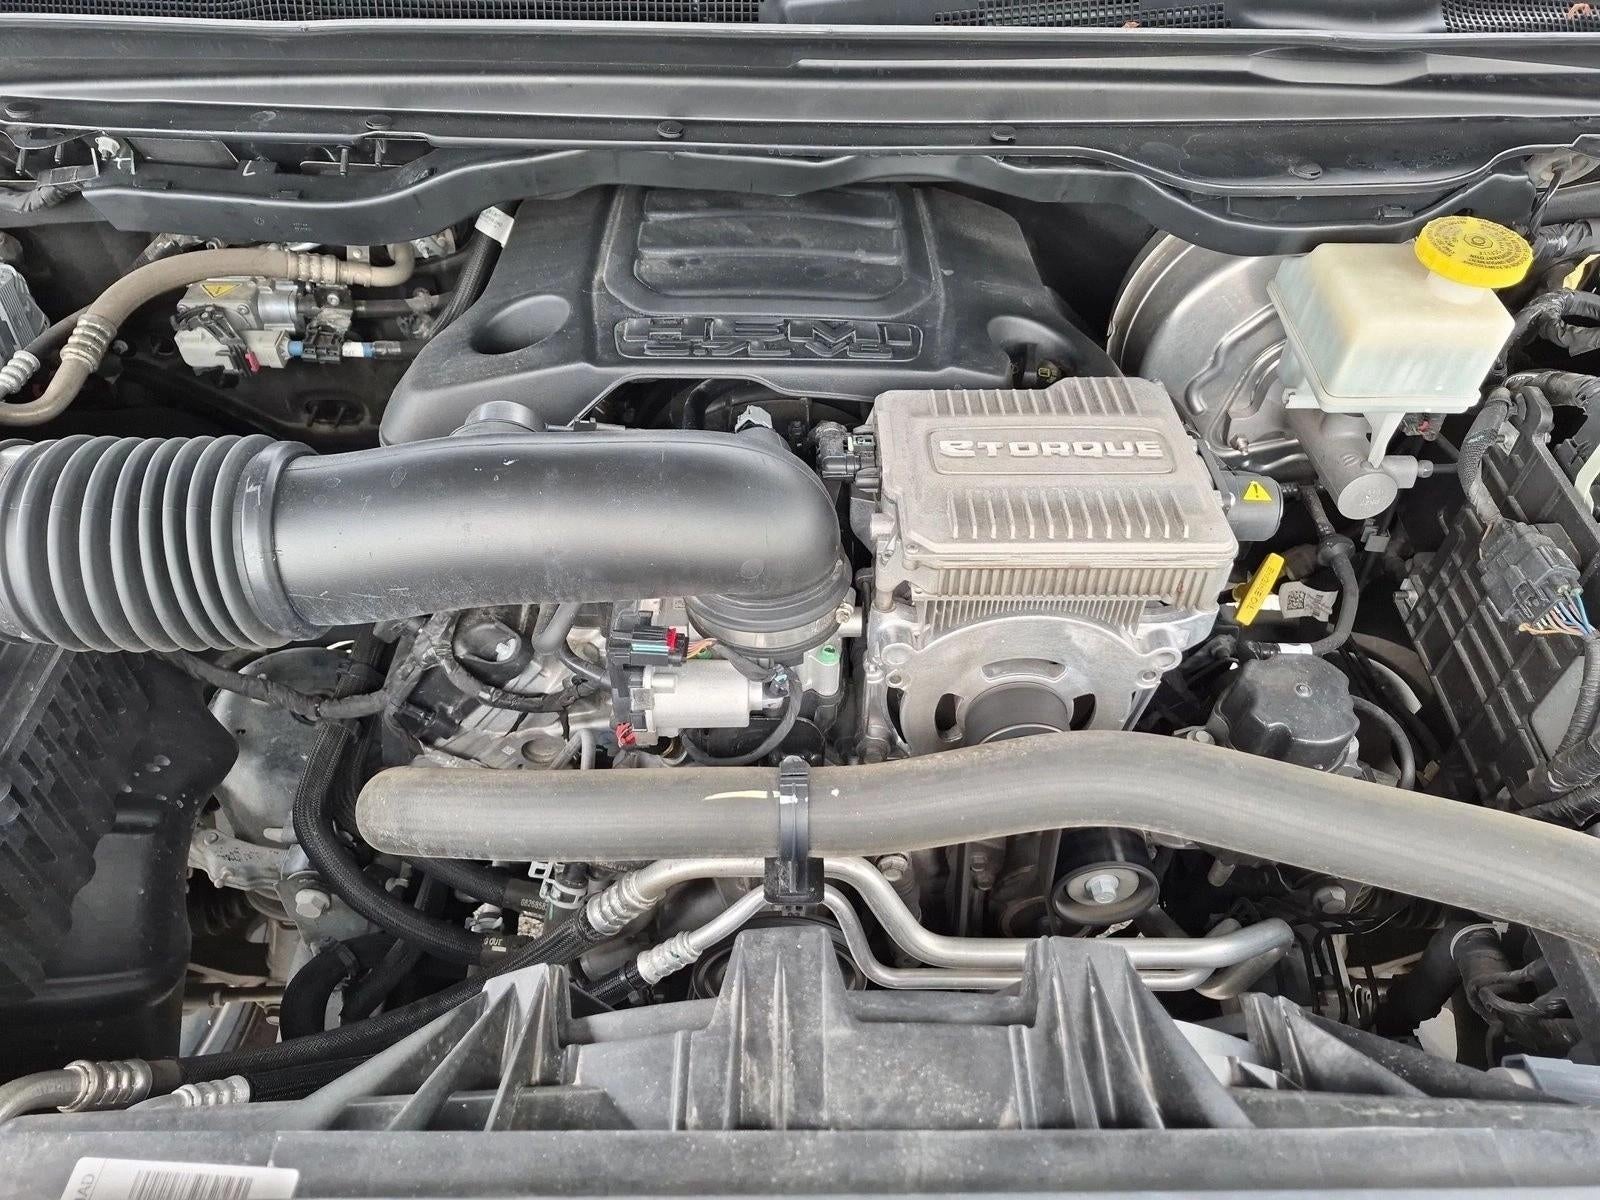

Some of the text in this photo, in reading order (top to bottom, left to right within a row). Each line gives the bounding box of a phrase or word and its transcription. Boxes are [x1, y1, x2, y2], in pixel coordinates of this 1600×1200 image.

[623, 317, 913, 346] HEMI
[1246, 566, 1275, 610] ENGINE OIL
